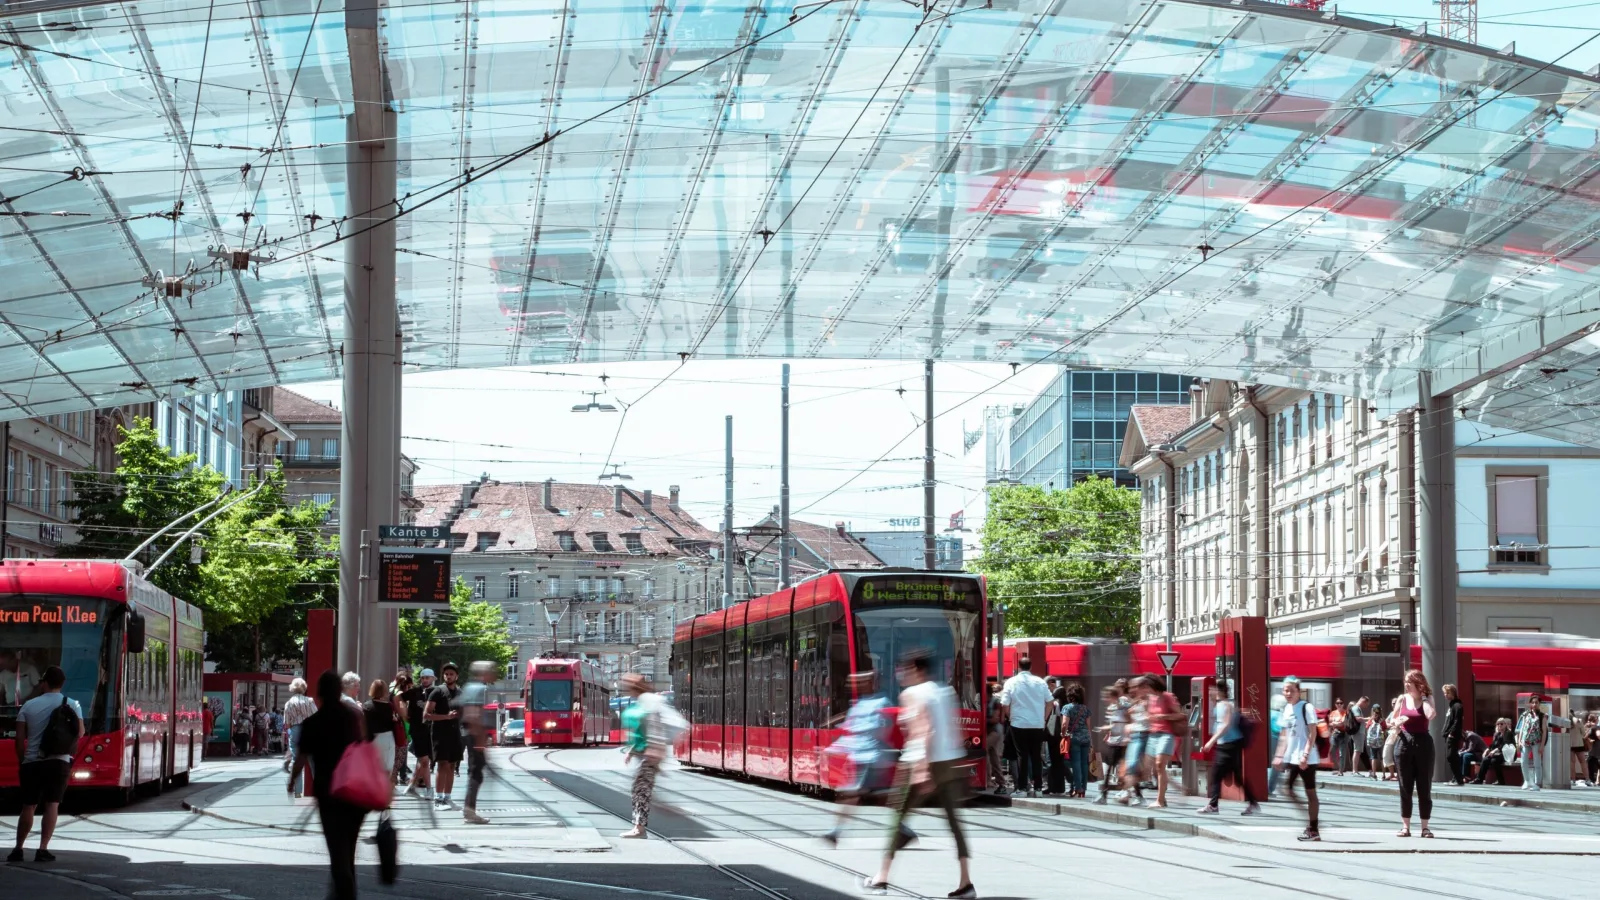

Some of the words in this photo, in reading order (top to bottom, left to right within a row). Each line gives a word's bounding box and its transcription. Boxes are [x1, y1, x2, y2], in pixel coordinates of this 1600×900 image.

[889, 517, 920, 527] suva
[389, 527, 427, 537] Kante
[432, 528, 439, 537] B
[863, 582, 874, 599] 8
[896, 582, 950, 591] Brünnen
[878, 592, 938, 600] Westside
[944, 592, 966, 600] Bhf
[0, 609, 29, 622] trum
[33, 605, 62, 622] Paul
[67, 605, 96, 622] Klee
